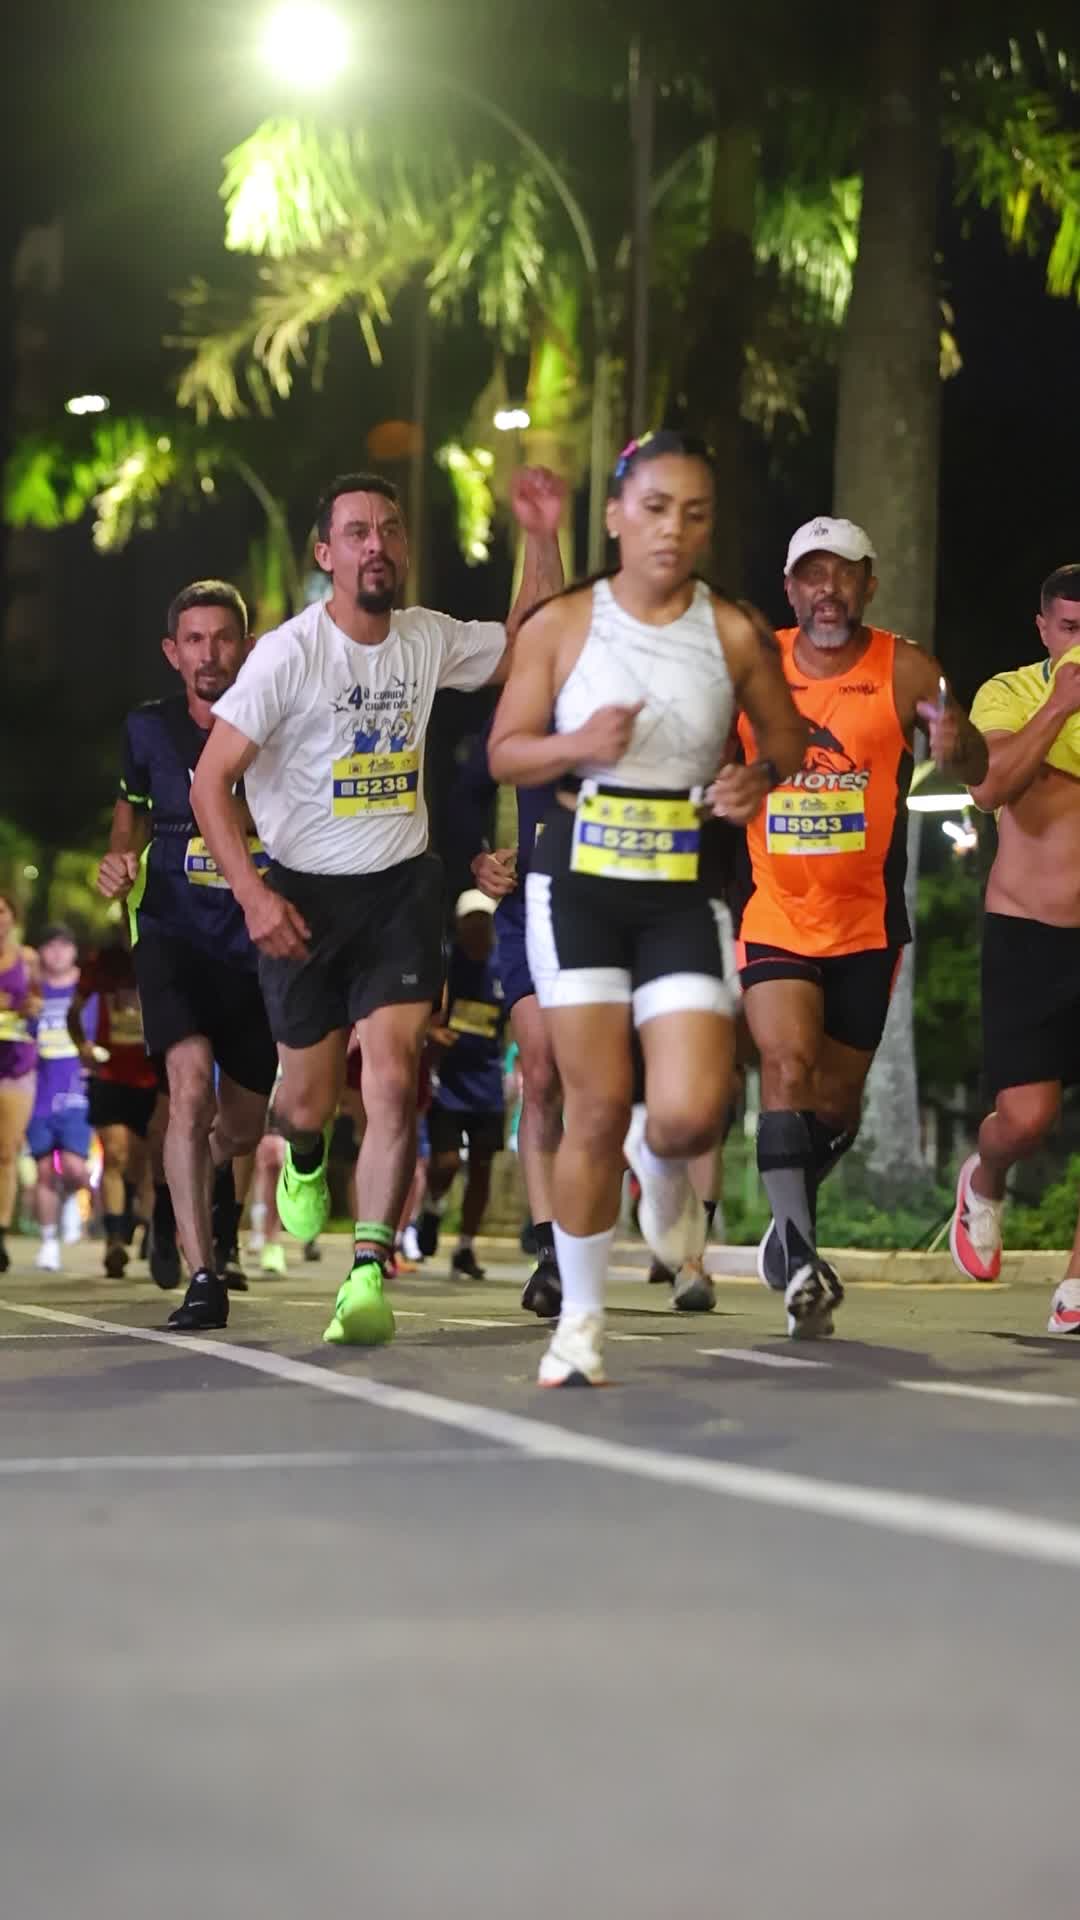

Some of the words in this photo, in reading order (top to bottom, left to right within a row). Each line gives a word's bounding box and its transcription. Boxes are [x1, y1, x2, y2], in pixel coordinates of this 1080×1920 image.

[356, 776, 408, 795] 5238
[788, 817, 842, 834] 5943
[603, 828, 674, 851] 5236
